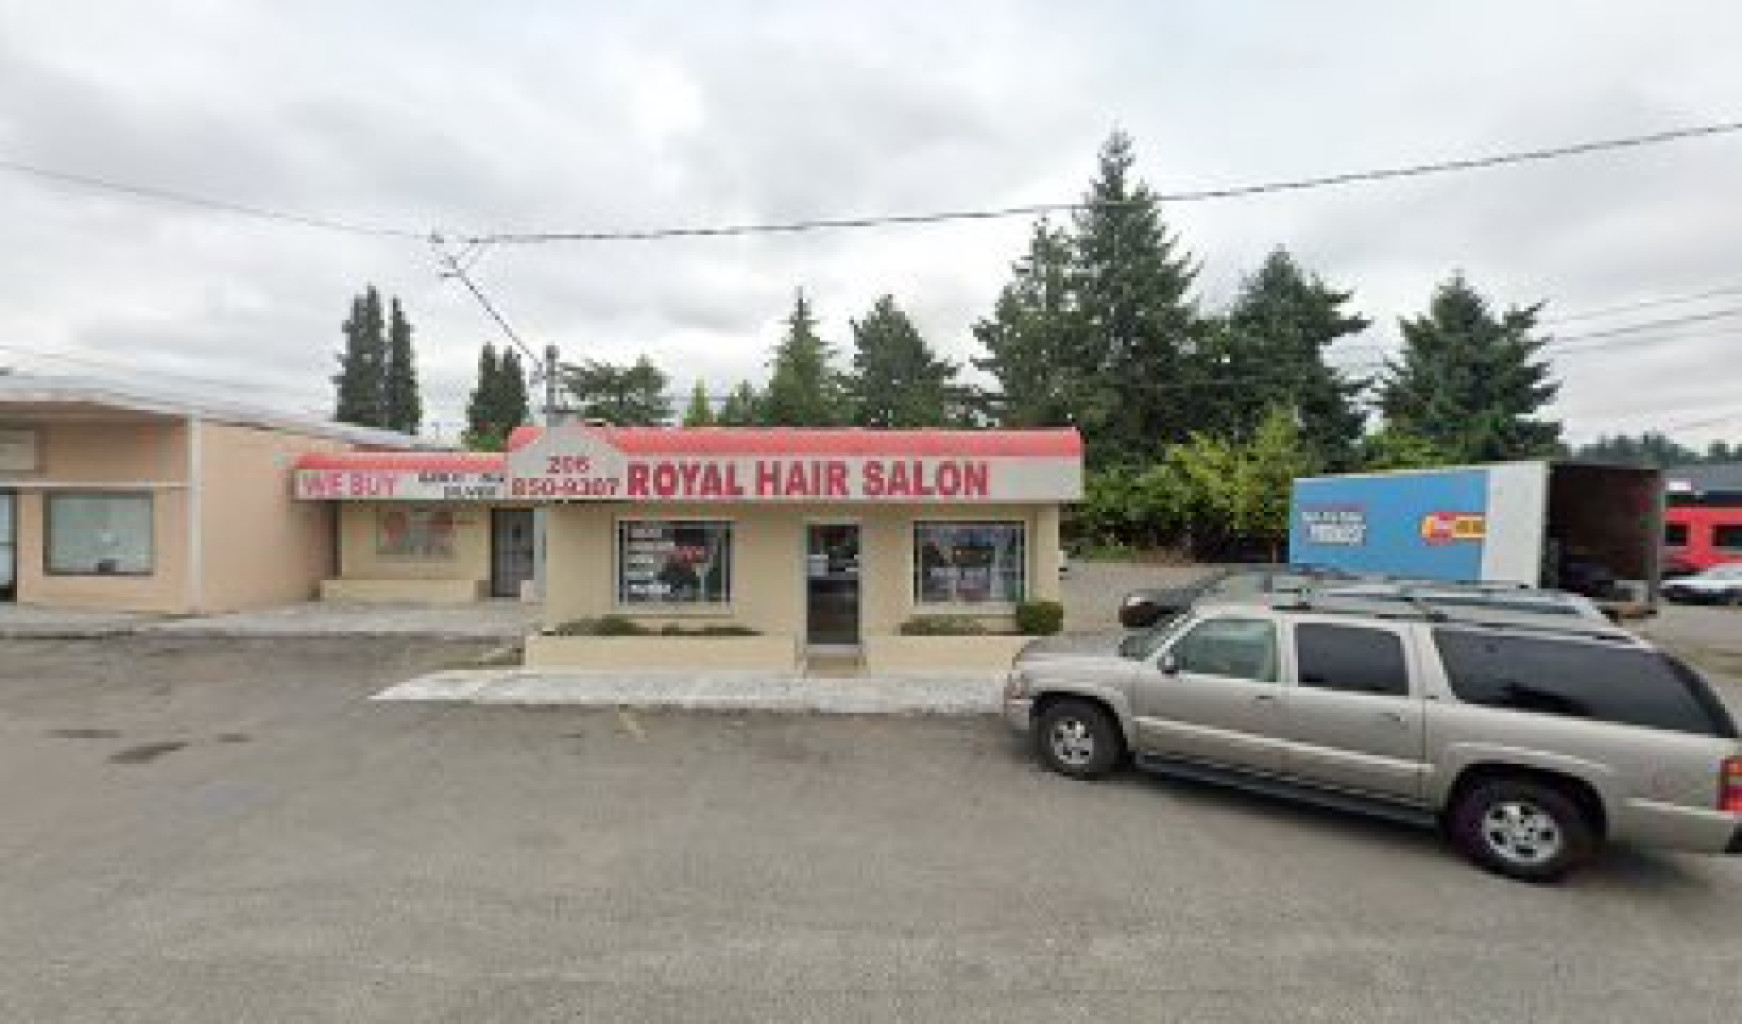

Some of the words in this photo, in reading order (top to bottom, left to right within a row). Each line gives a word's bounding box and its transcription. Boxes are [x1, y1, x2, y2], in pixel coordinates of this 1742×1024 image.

[546, 455, 591, 474] 206
[302, 472, 343, 496] WE
[349, 472, 397, 496] BUY
[627, 463, 744, 497] ROYAL
[755, 461, 849, 497] HAIR
[862, 461, 990, 497] SALON
